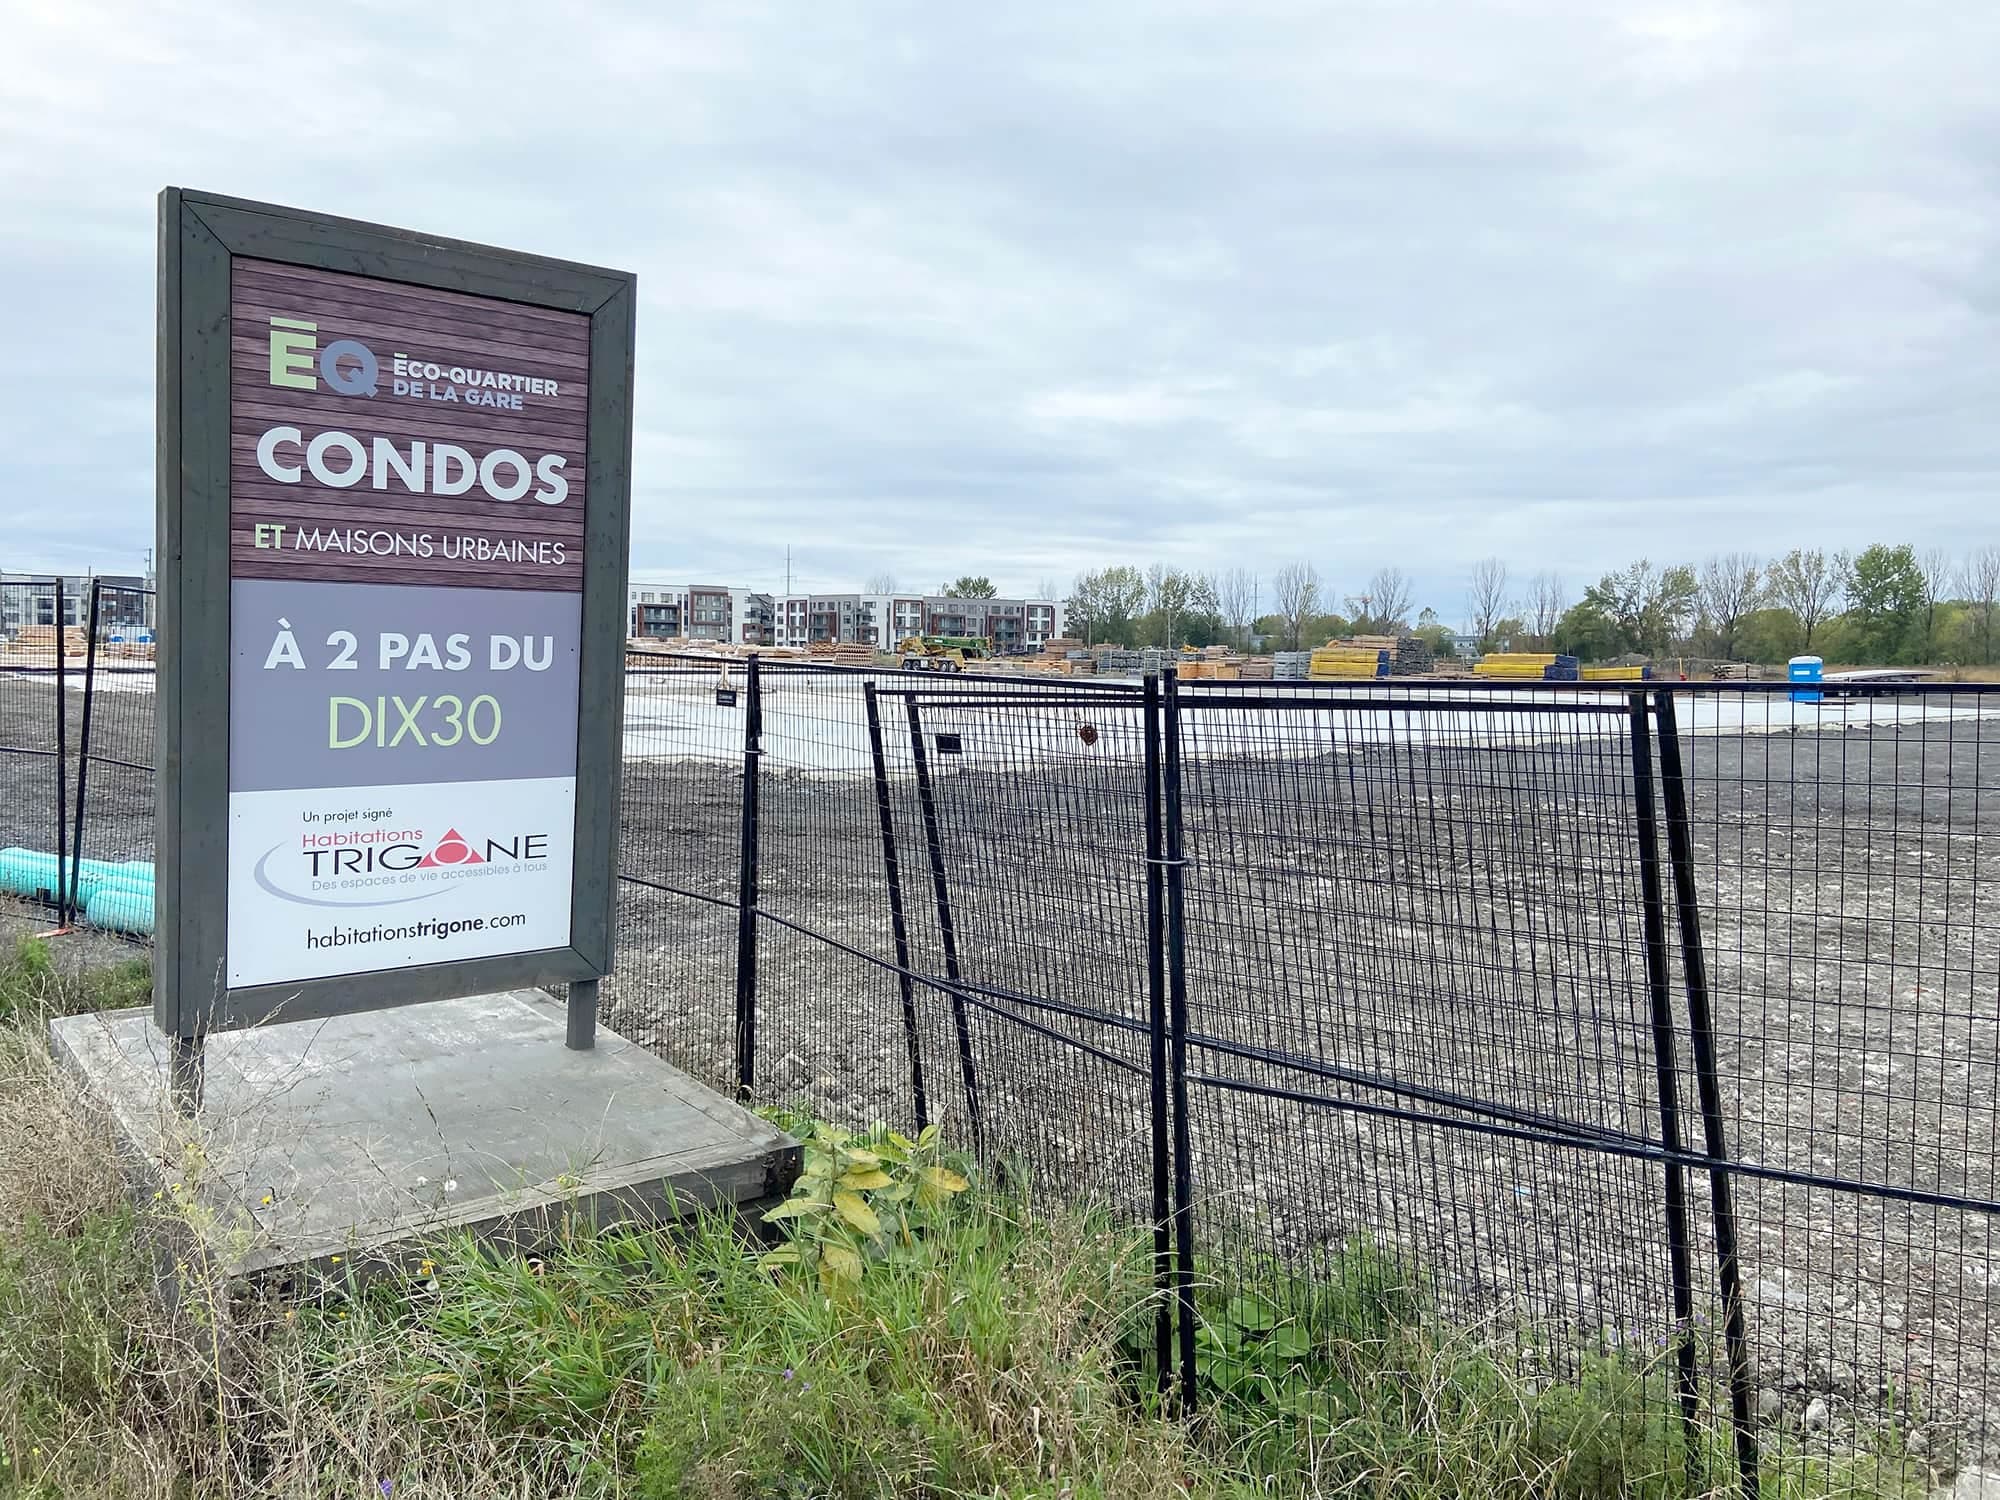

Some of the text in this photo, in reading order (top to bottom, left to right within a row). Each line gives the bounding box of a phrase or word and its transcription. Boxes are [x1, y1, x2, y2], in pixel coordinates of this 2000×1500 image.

[393, 378, 523, 411] DE LA GARE
[257, 426, 569, 505] CONDOS
[255, 523, 565, 565] ET MAISONS URBAINES
[264, 617, 554, 671] À 2 PAS DU
[329, 694, 502, 749] DIX30
[303, 807, 393, 825] Un projet signé
[302, 828, 423, 848] Habitations
[302, 833, 548, 877] TRIGONE
[312, 860, 547, 891] Des espaces de vie accessibles à tous
[307, 913, 526, 949] habitationstrigone.com
